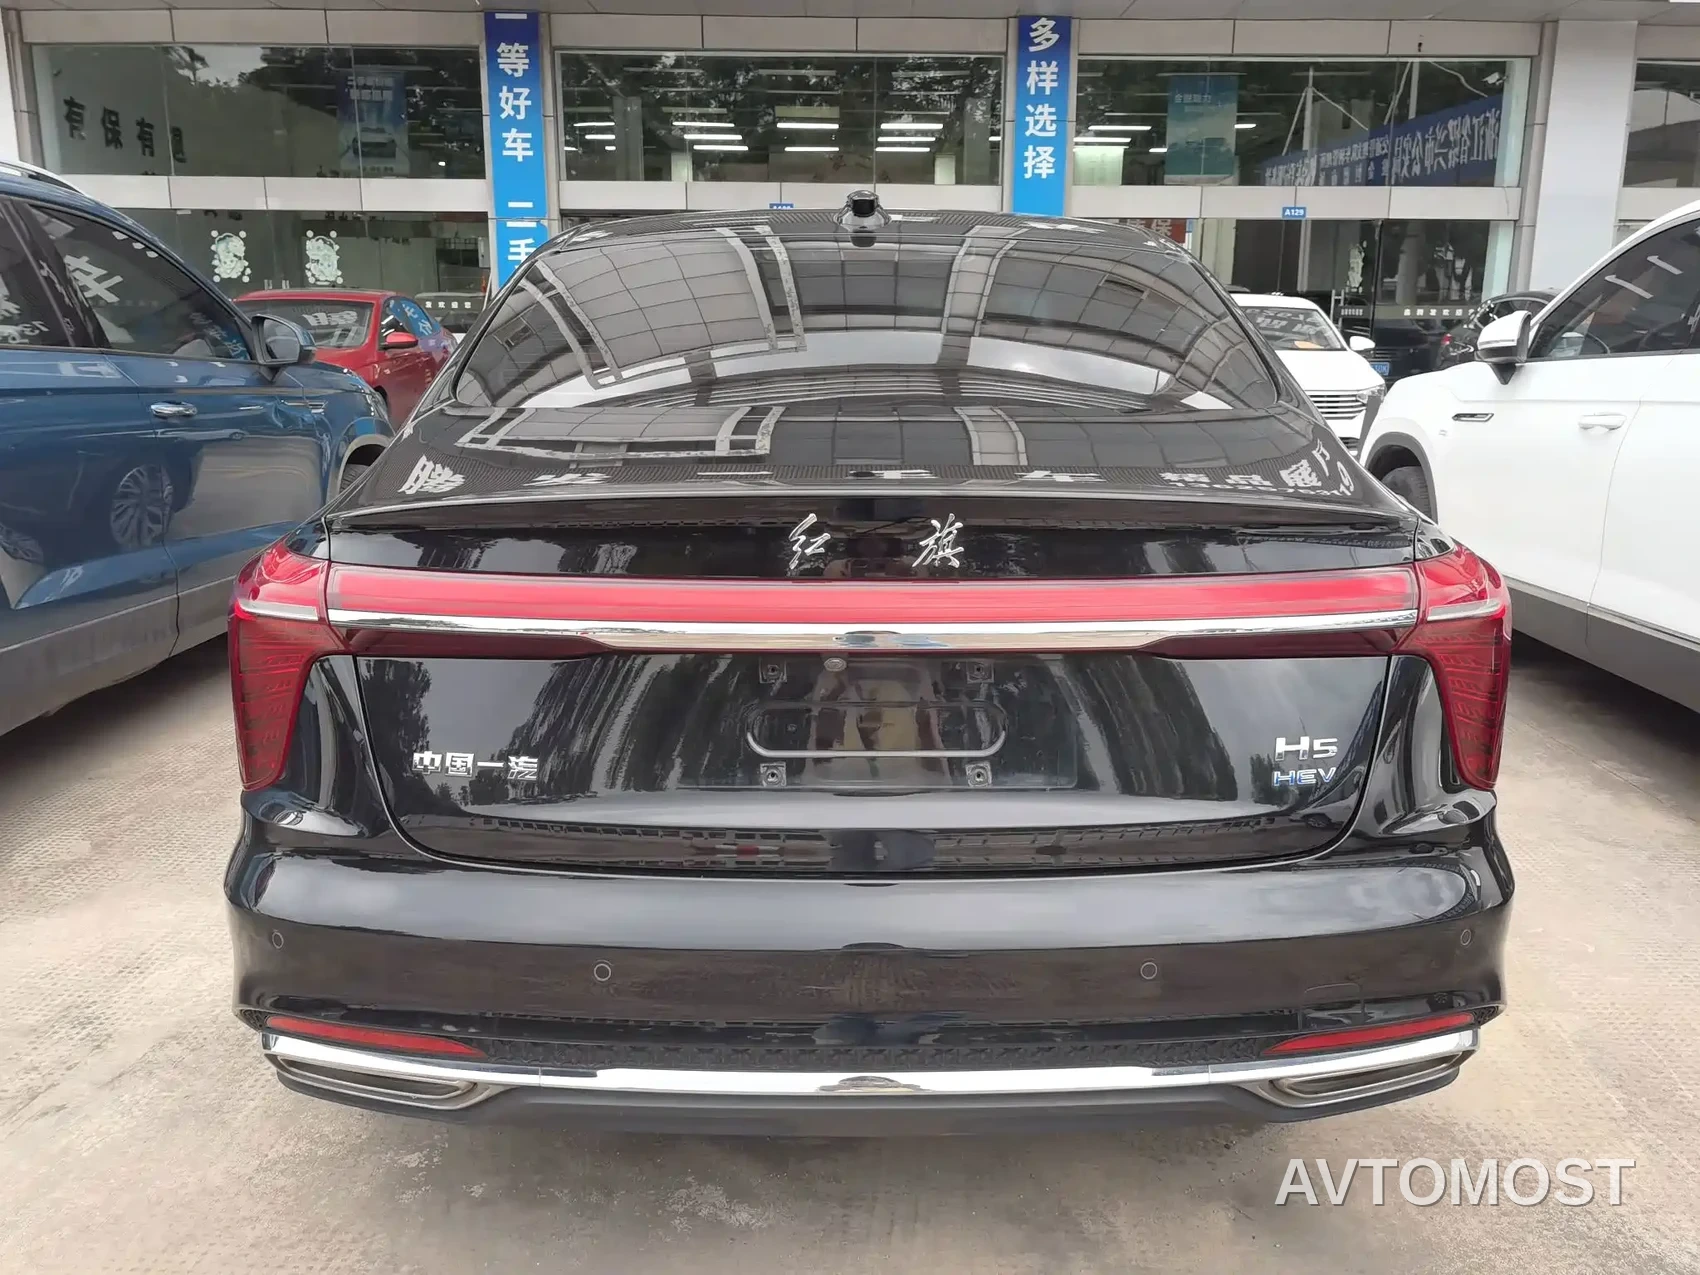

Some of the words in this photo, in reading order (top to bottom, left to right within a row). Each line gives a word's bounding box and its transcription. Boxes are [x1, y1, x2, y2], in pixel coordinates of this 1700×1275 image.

[495, 13, 534, 162] 一等好车
[1024, 17, 1060, 179] 多样选择
[788, 513, 964, 569] 红旗
[412, 751, 538, 780] 中国一汽
[1275, 736, 1338, 761] H5
[1273, 767, 1337, 787] HEV
